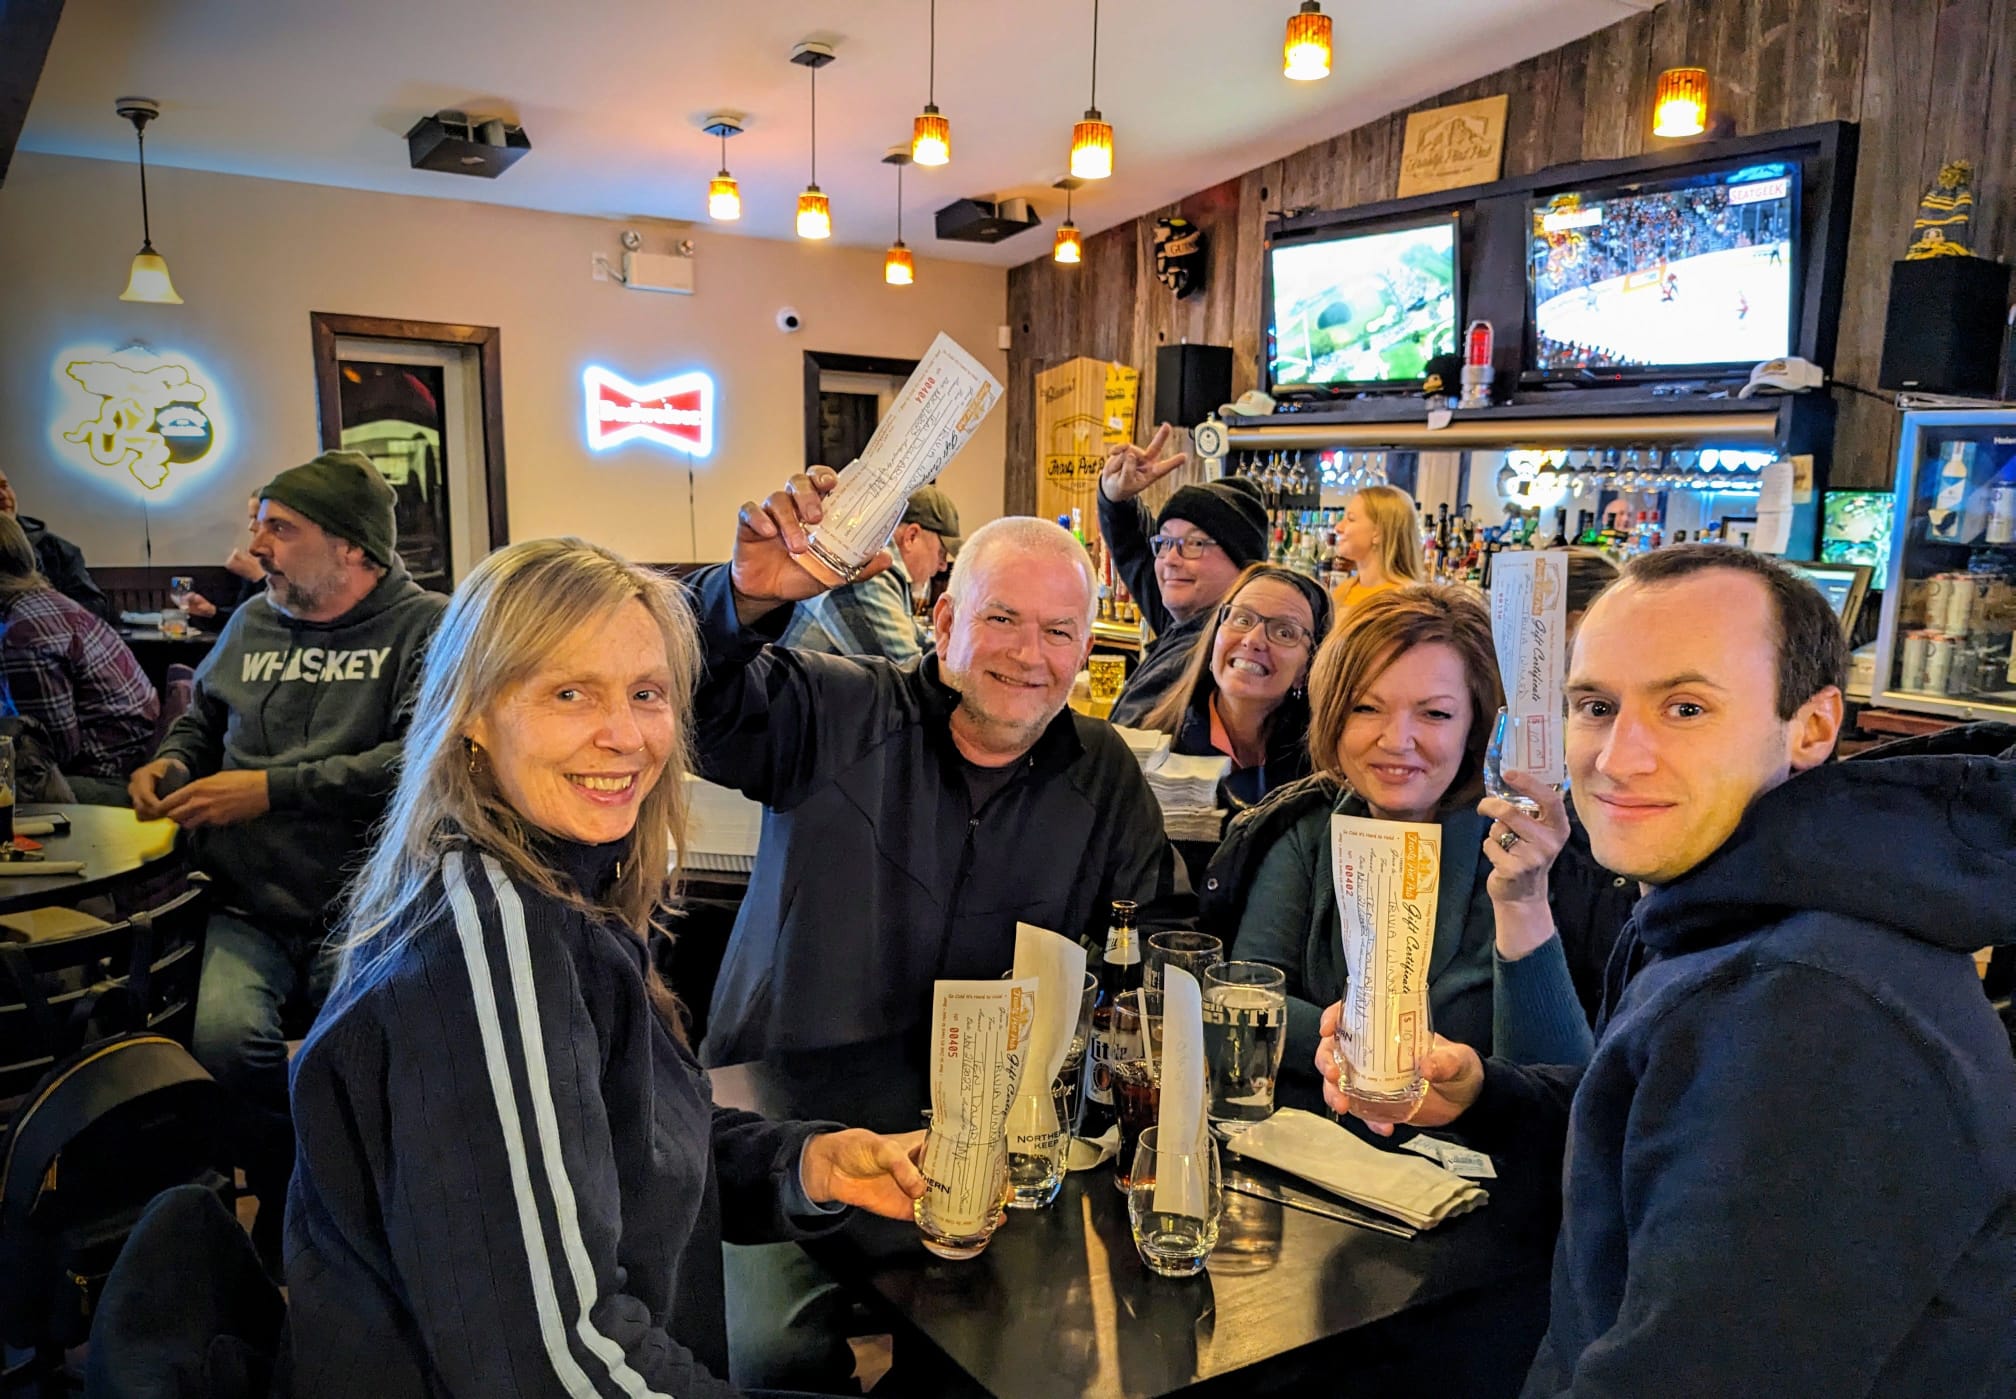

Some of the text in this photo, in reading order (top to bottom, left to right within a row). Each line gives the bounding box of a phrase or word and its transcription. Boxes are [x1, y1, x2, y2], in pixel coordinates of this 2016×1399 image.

[1532, 618, 1546, 647] Gift
[241, 647, 392, 684] WHISKEY
[1528, 647, 1546, 702] Certificate
[1344, 864, 1354, 898] 00402
[1400, 901, 1422, 994] Gift Certificate
[948, 1027, 959, 1058] 00405
[1007, 1053, 1020, 1081] Gift
[1034, 1139, 1059, 1149] KEEP
